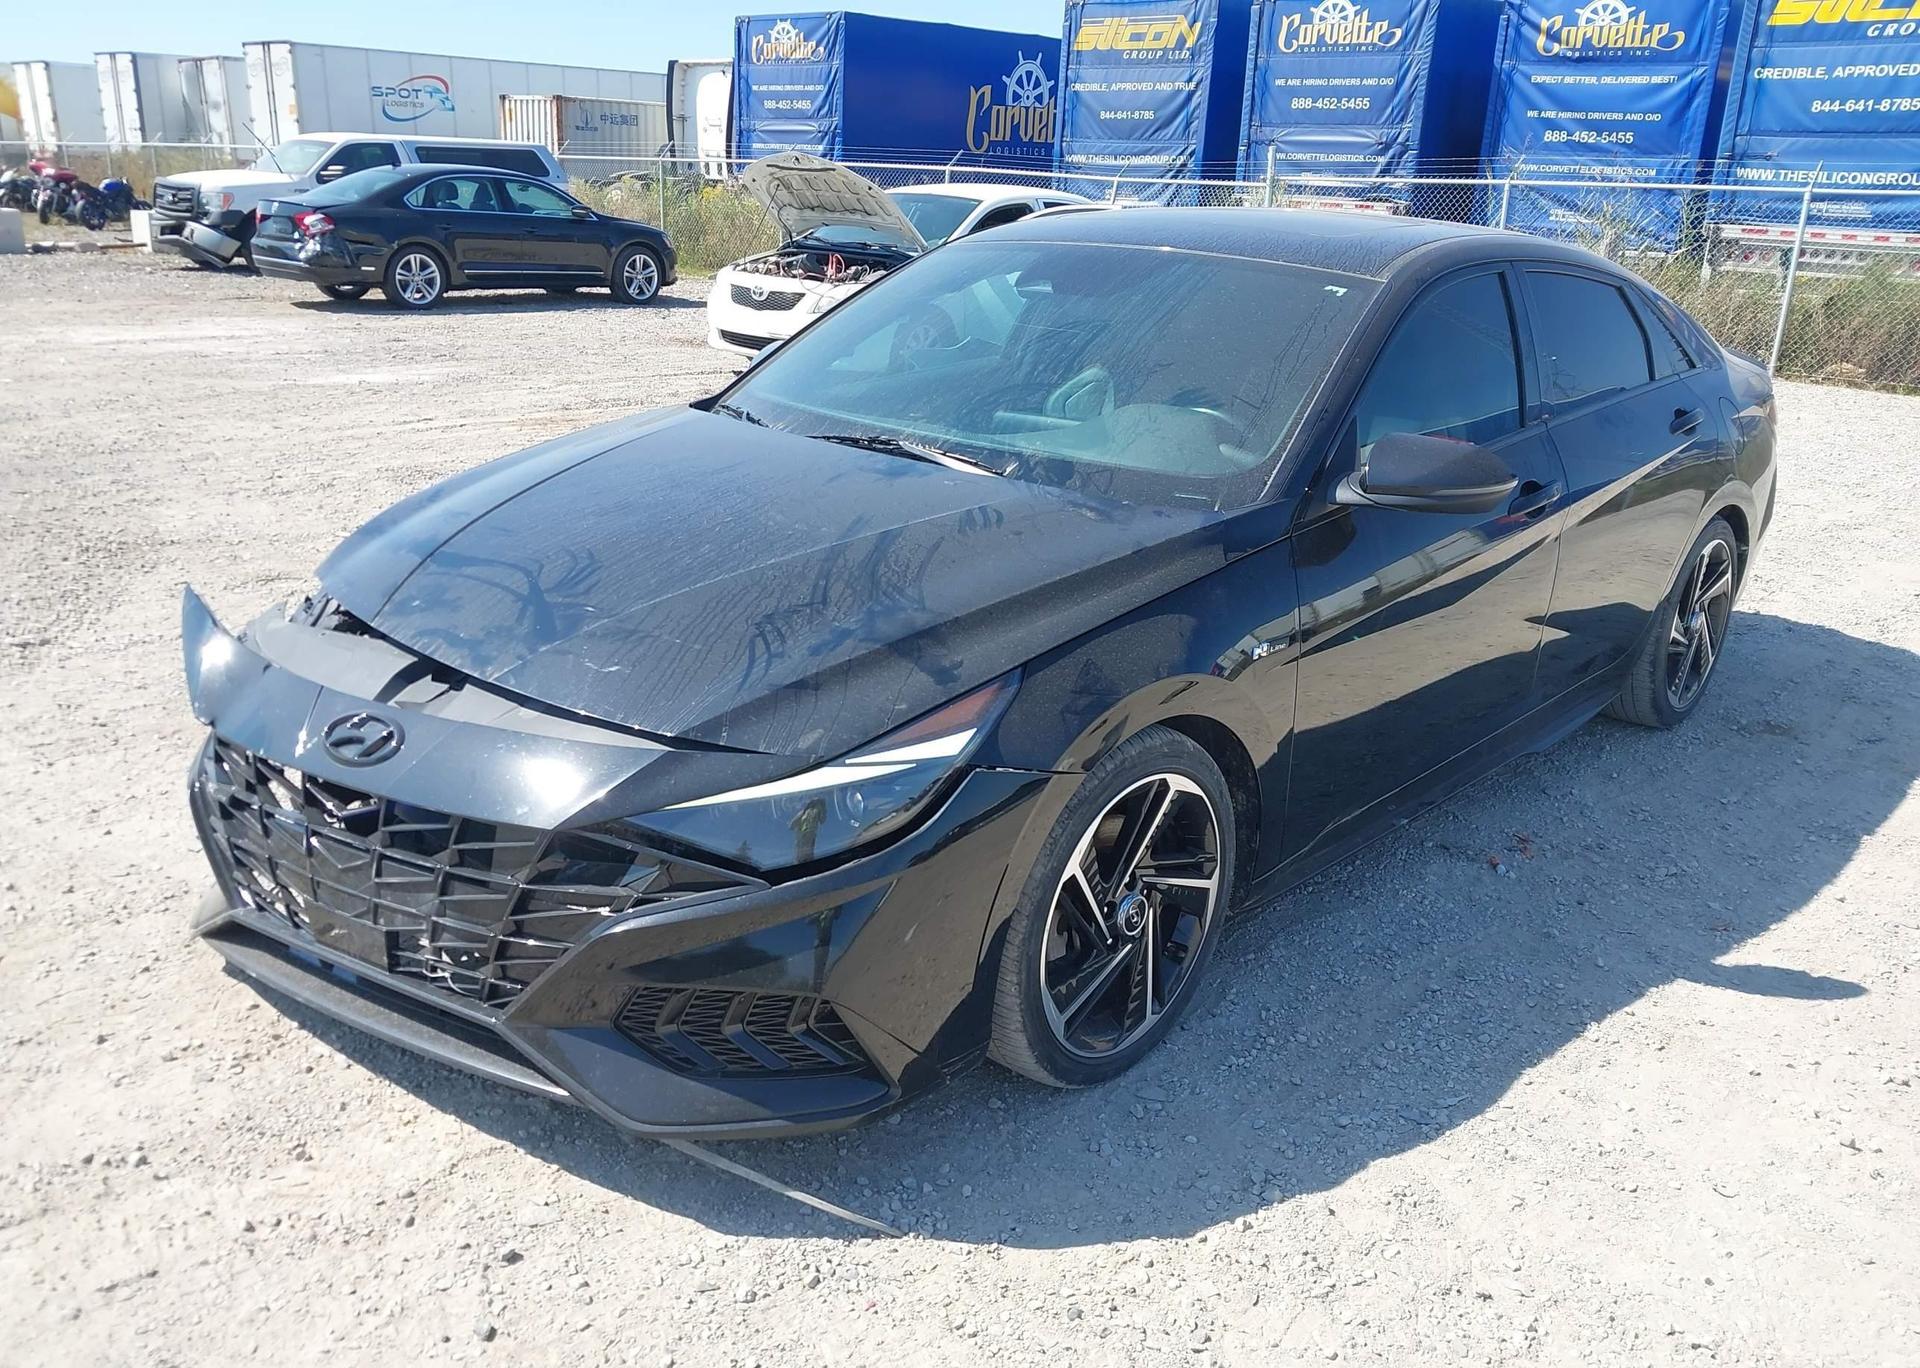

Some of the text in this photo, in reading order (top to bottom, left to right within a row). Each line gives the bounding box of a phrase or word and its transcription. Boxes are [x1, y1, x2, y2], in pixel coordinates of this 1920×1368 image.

[1278, 7, 1402, 53] Corvette
[1536, 10, 1686, 56] Corvette
[1866, 22, 1920, 37] GRO
[752, 31, 824, 65] Corvette
[1123, 50, 1193, 60] GROUP LTD.
[1753, 63, 1920, 81] CREDIBLE, APPROVED
[1070, 81, 1197, 92] CREDIBLE, APPROVED AND TRUE
[1275, 77, 1395, 86] WE ARE HIRING DRIVERS AND O/O
[1531, 75, 1679, 85] EXPECT BETTER, DELIVERED BEST!
[370, 86, 423, 100] SPOT
[386, 100, 425, 108] LOGISTICS
[1291, 97, 1371, 109] 888-452-5455
[1811, 98, 1920, 113] 844-641-8785
[600, 112, 639, 127] 中远集团
[1099, 110, 1155, 120] 844-641-8785
[1527, 110, 1662, 121] WE ARE HIRING DRIVERS AND O/O
[1543, 129, 1635, 144] 888-452-5455
[989, 146, 1046, 156] LOGISTICS
